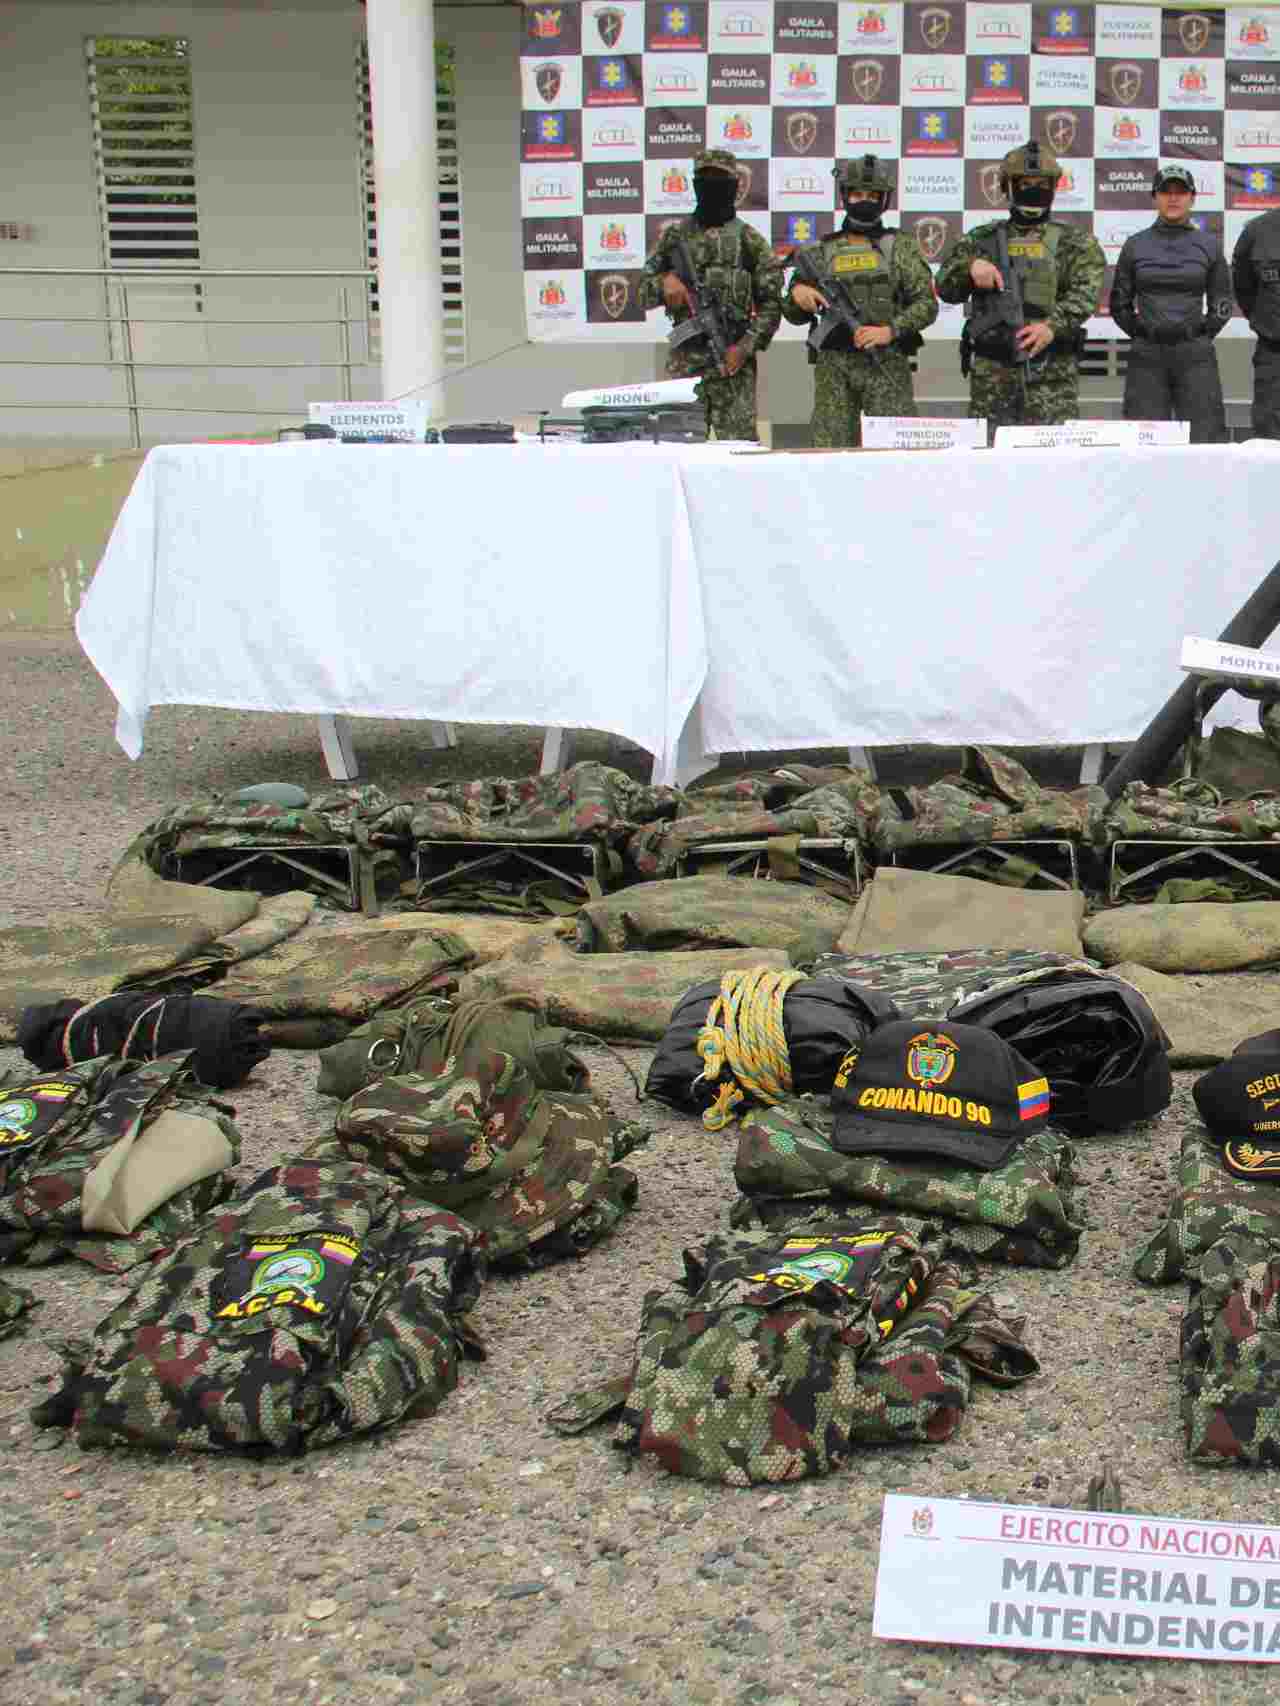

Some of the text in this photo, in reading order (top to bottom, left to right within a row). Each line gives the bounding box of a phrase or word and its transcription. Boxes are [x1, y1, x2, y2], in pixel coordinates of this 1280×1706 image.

[330, 415, 405, 425] ELEMENTOS
[858, 1087, 992, 1125] COMANDO 90
[1000, 1513, 1129, 1548] EJERCITO
[1001, 1556, 1217, 1608] MATERIAL
